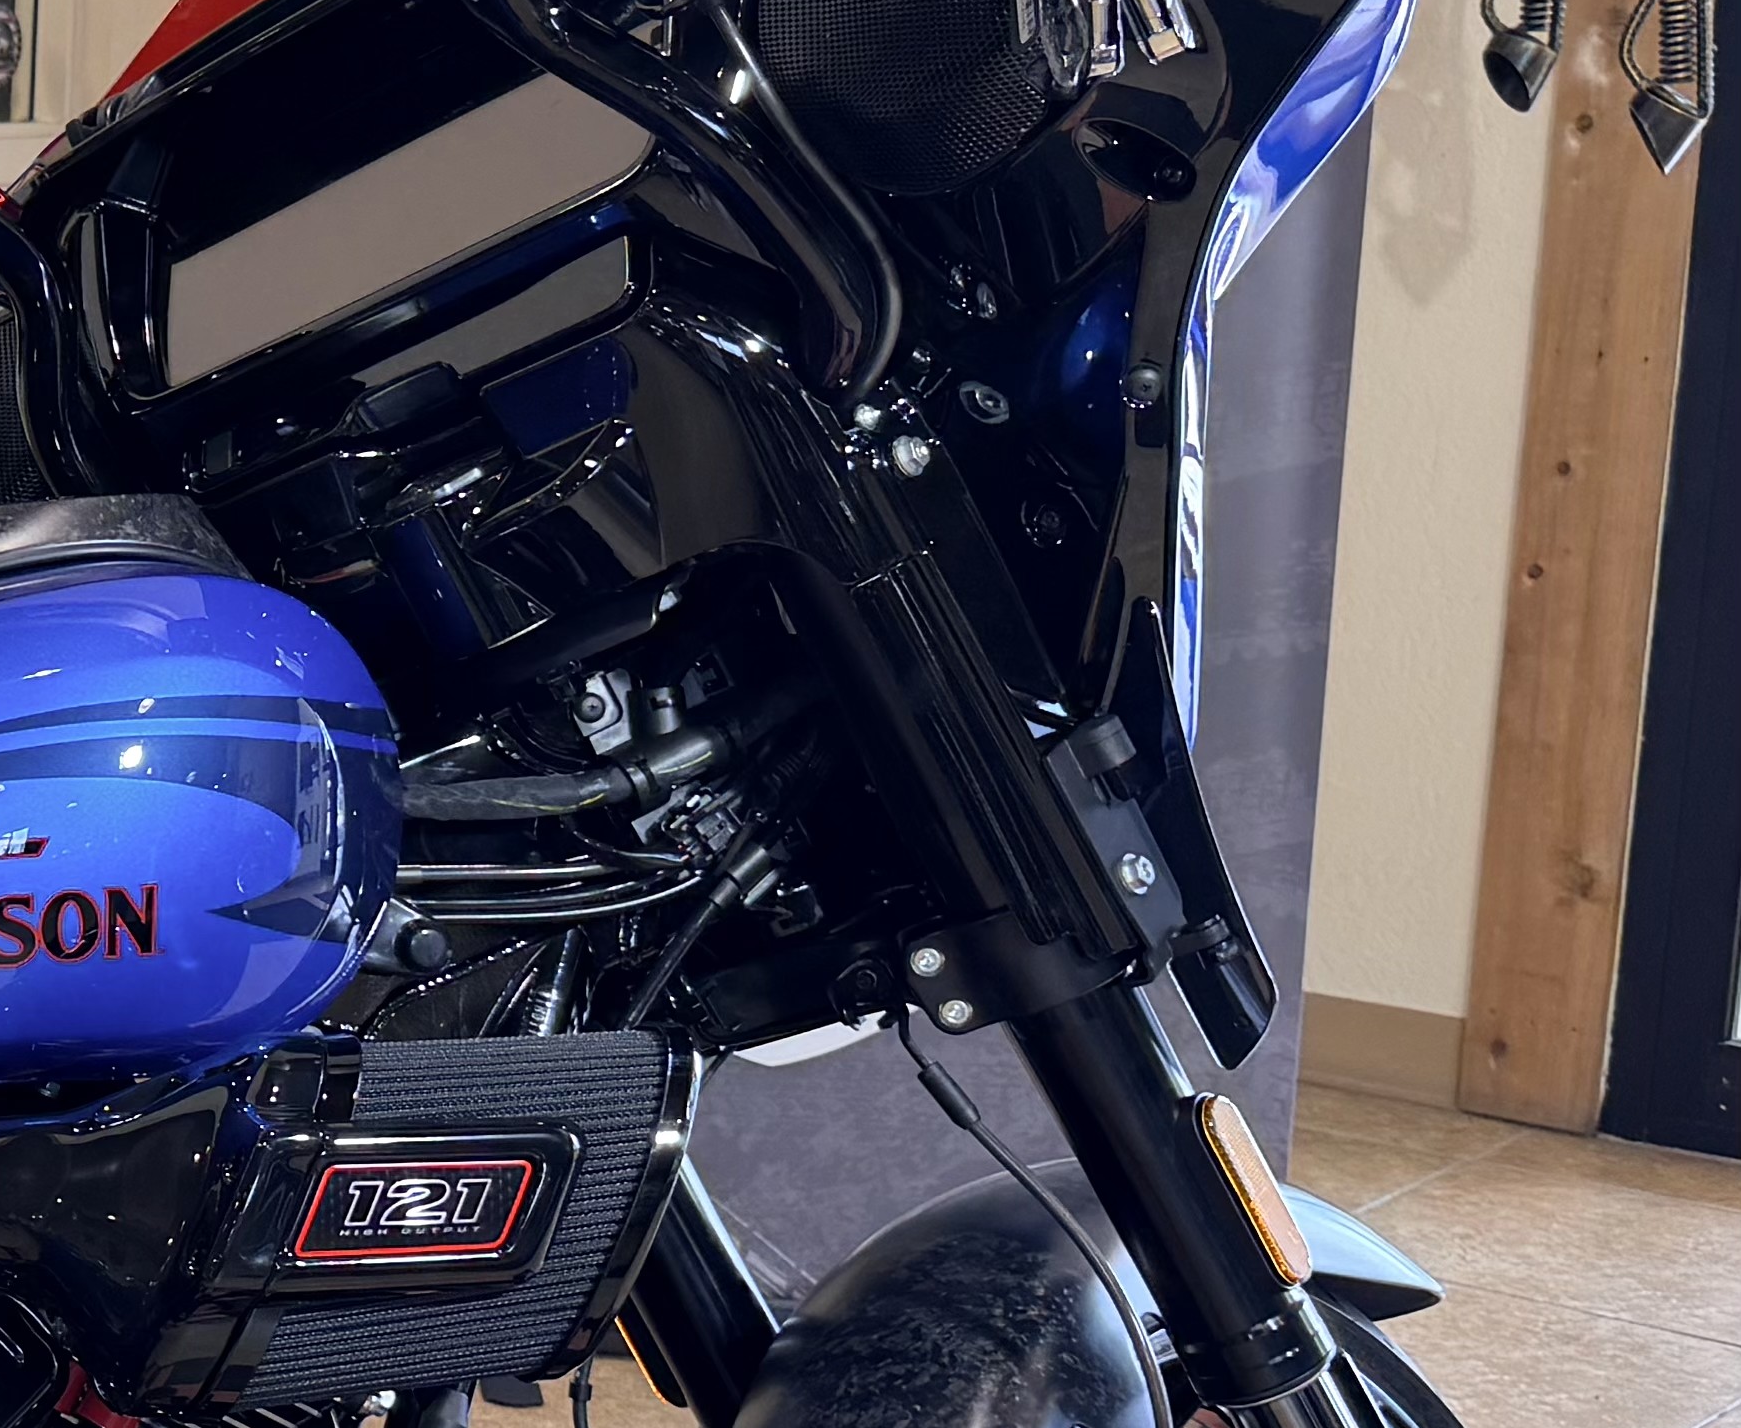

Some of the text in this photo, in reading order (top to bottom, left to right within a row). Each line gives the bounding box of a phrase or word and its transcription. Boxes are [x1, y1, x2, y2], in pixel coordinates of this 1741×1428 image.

[344, 1178, 492, 1227] 121
[339, 1225, 482, 1237] HIGH OUTPUT
